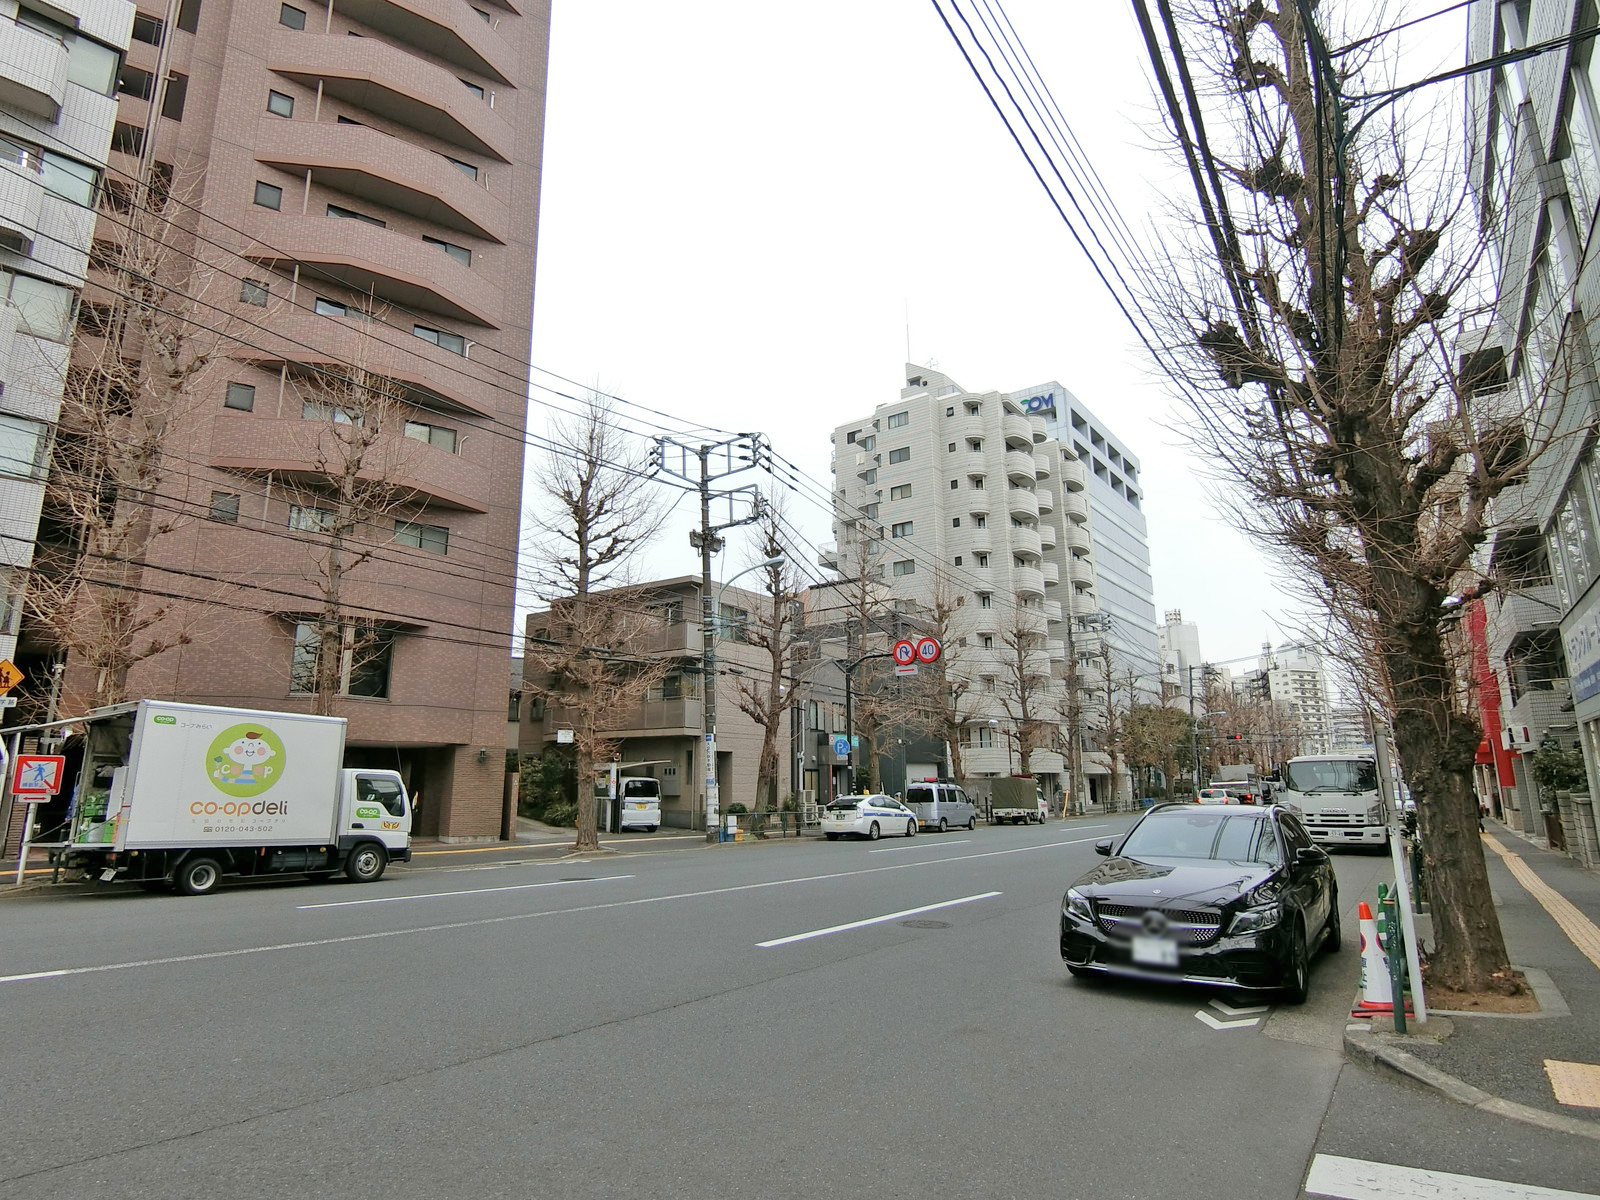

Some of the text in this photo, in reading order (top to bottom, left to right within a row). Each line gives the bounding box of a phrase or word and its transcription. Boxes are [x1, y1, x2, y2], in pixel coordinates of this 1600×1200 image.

[922, 644, 934, 655] 40
[181, 722, 213, 730] コープみらい
